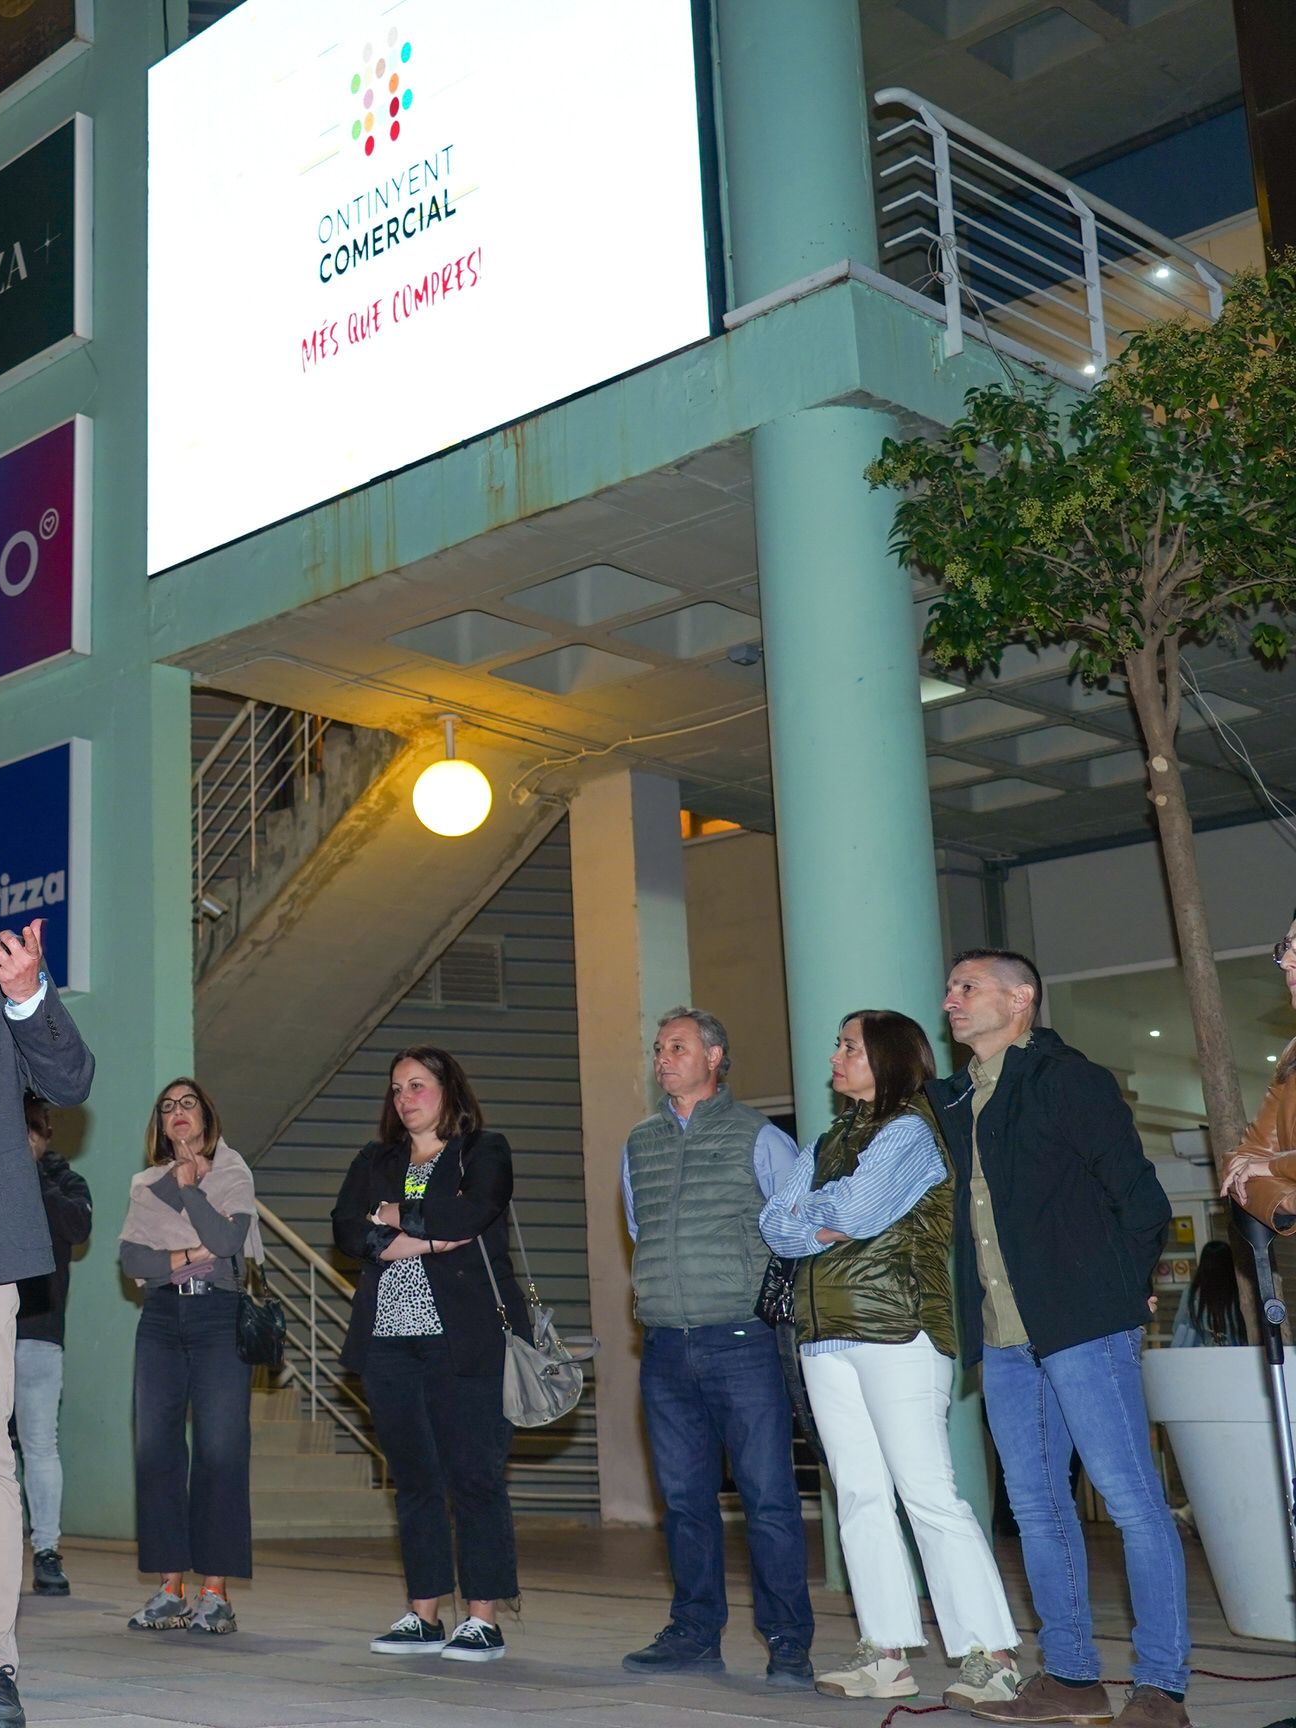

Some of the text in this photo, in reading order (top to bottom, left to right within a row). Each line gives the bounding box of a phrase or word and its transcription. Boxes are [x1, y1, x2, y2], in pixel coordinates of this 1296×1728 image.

[318, 144, 454, 244] ONTINYENT
[320, 189, 456, 283] COMERCIAL
[302, 247, 482, 373] MÉS QUE COMPRES!
